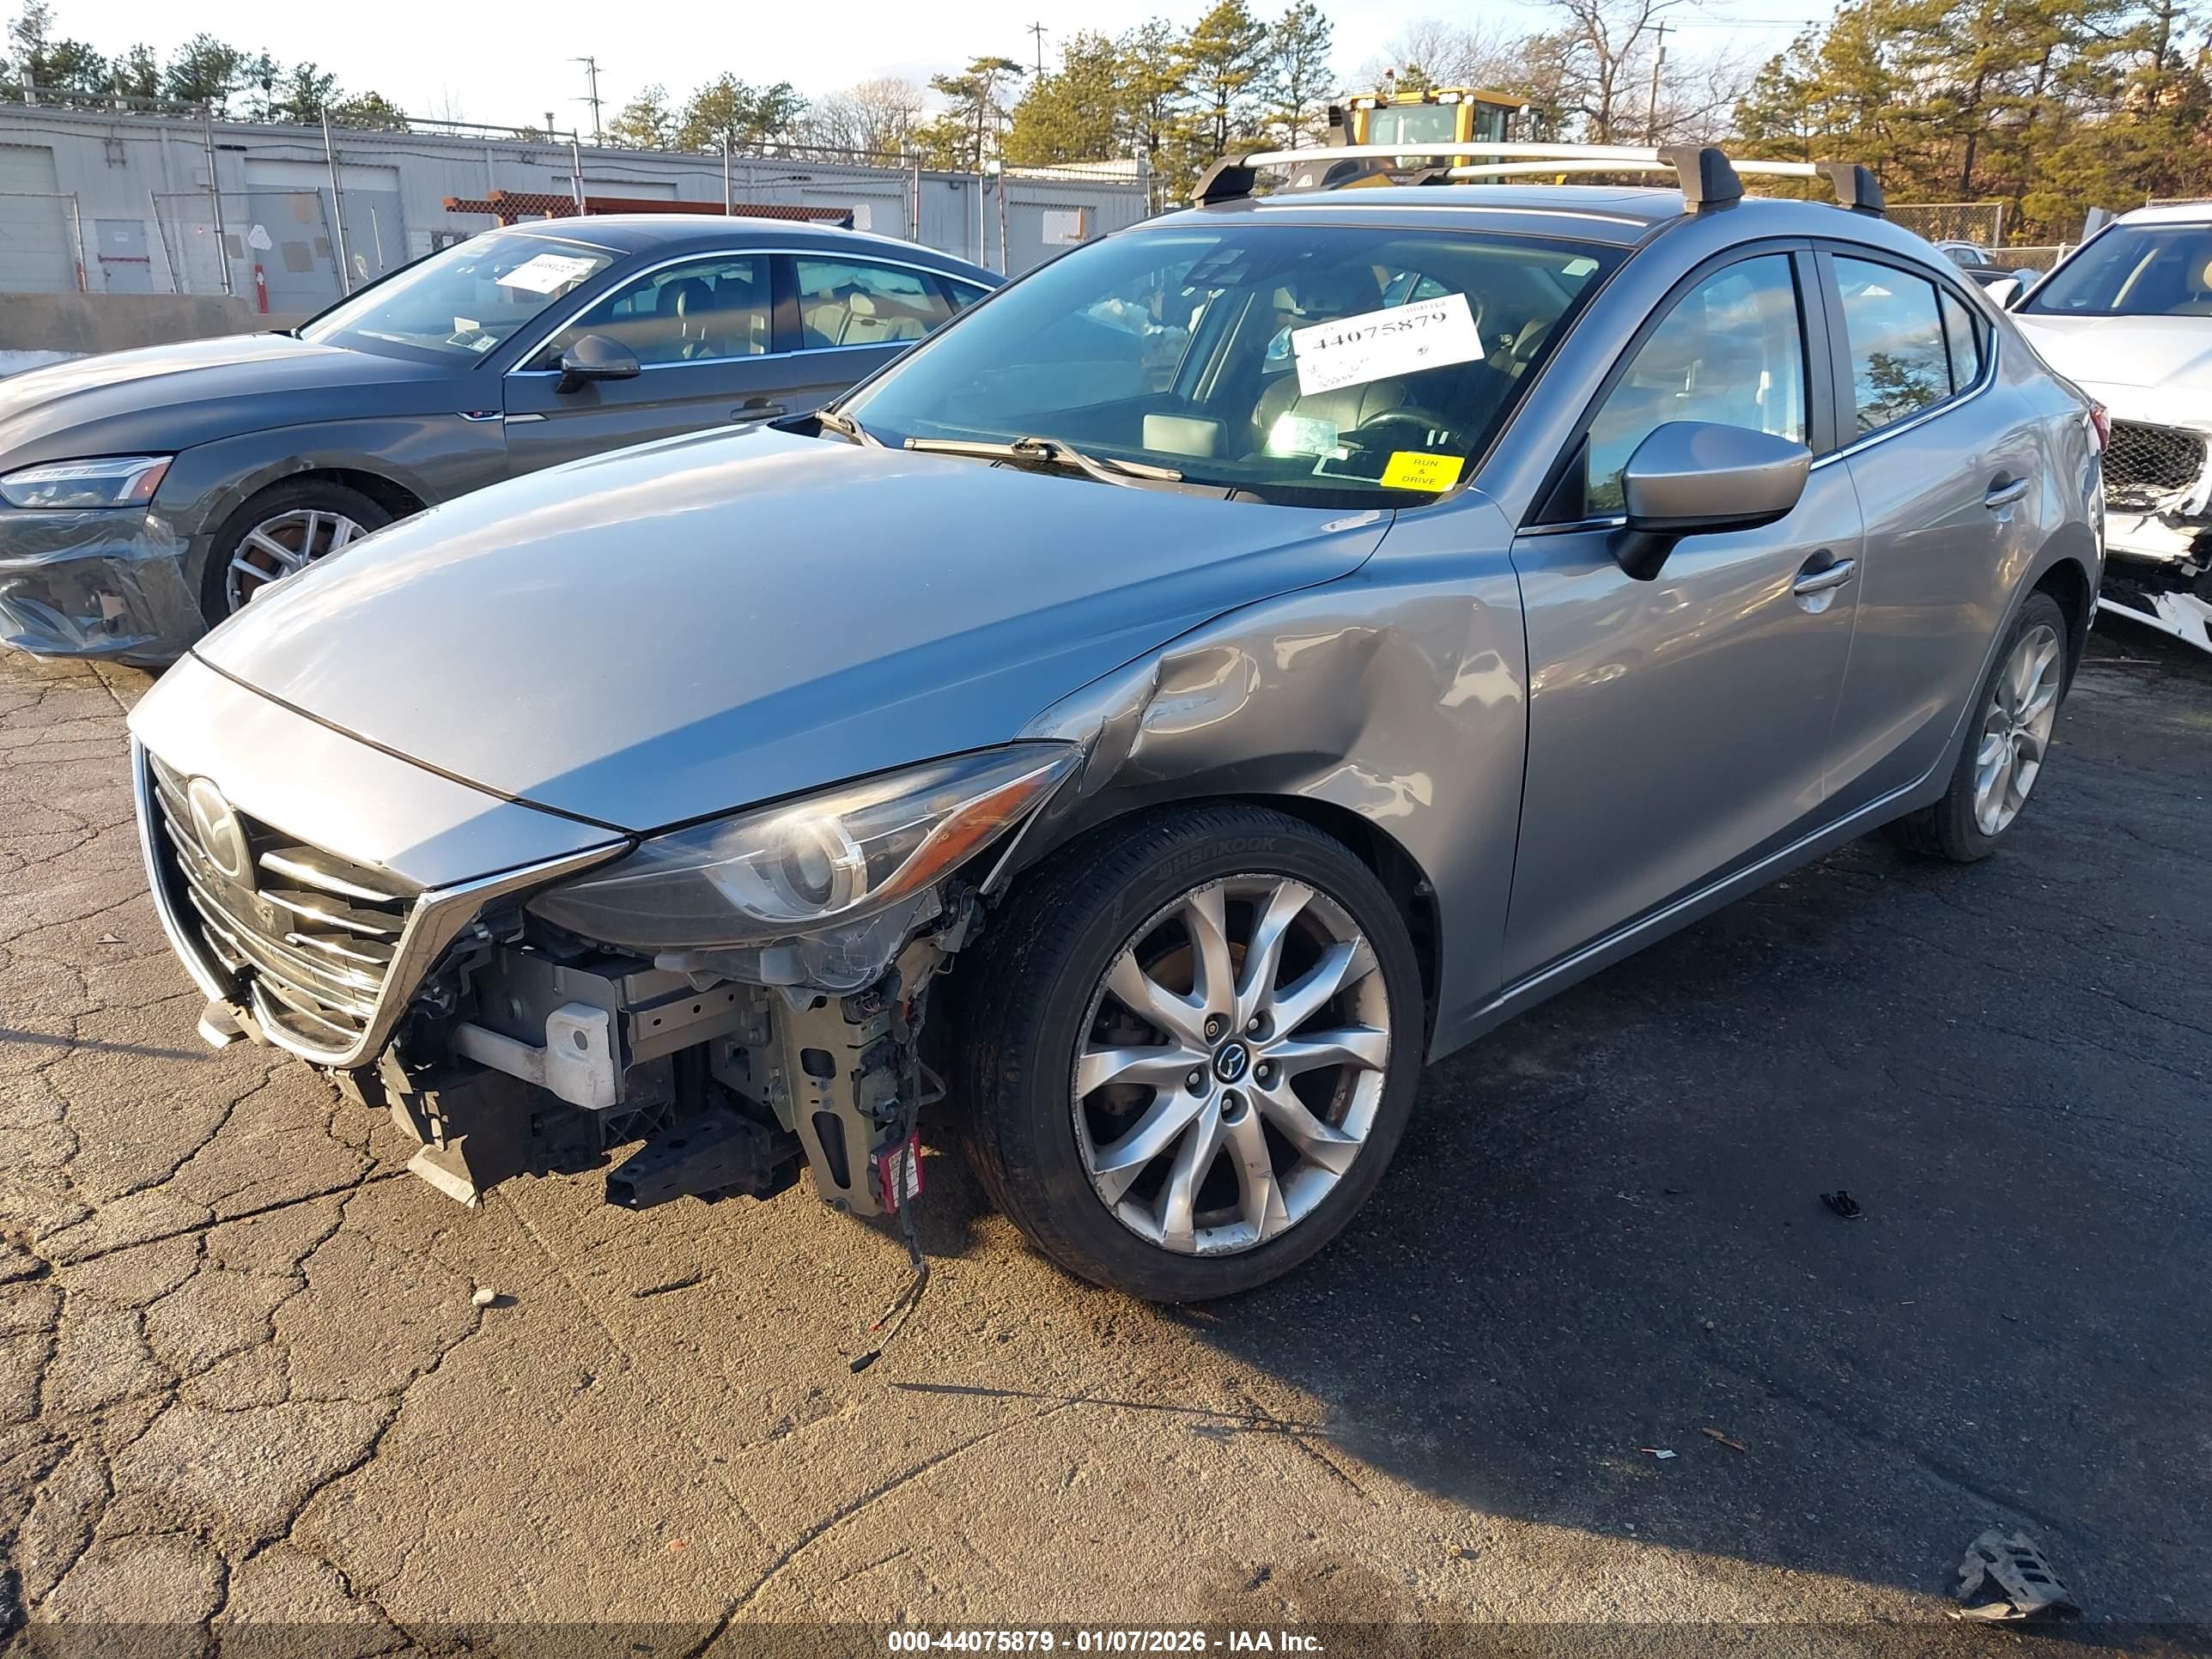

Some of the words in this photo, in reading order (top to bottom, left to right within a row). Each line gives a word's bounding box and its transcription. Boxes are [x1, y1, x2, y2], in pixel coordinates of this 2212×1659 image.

[1313, 312, 1448, 349] 44075879
[1413, 459, 1439, 467] RUN
[1401, 476, 1437, 485] DRIVE
